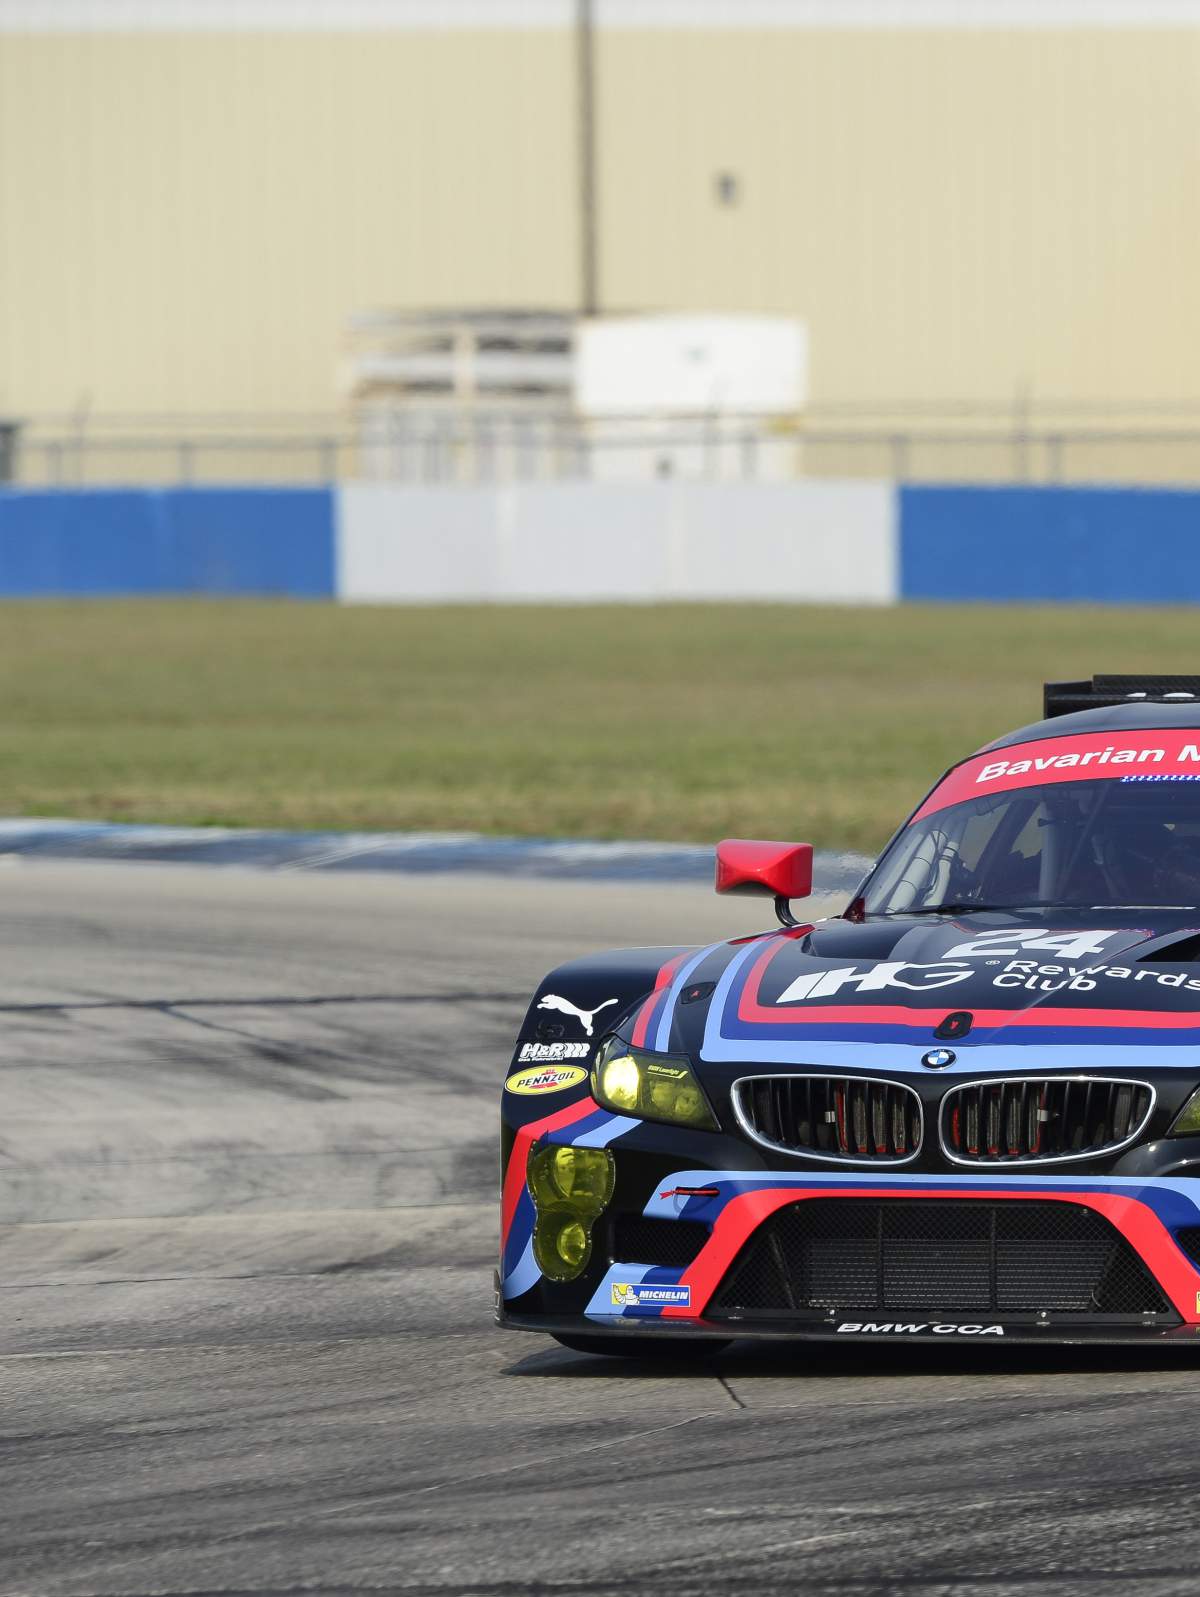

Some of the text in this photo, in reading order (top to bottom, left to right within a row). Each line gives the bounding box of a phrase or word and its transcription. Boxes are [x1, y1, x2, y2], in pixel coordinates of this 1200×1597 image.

[975, 747, 1166, 783] Bavarian
[942, 929, 1119, 959] 24
[775, 961, 976, 1003] IHG
[992, 973, 1098, 991] Club
[516, 1072, 576, 1088] PENNZOIL
[639, 1290, 689, 1300] MICHELIN
[837, 1323, 1005, 1336] BMW CCA
